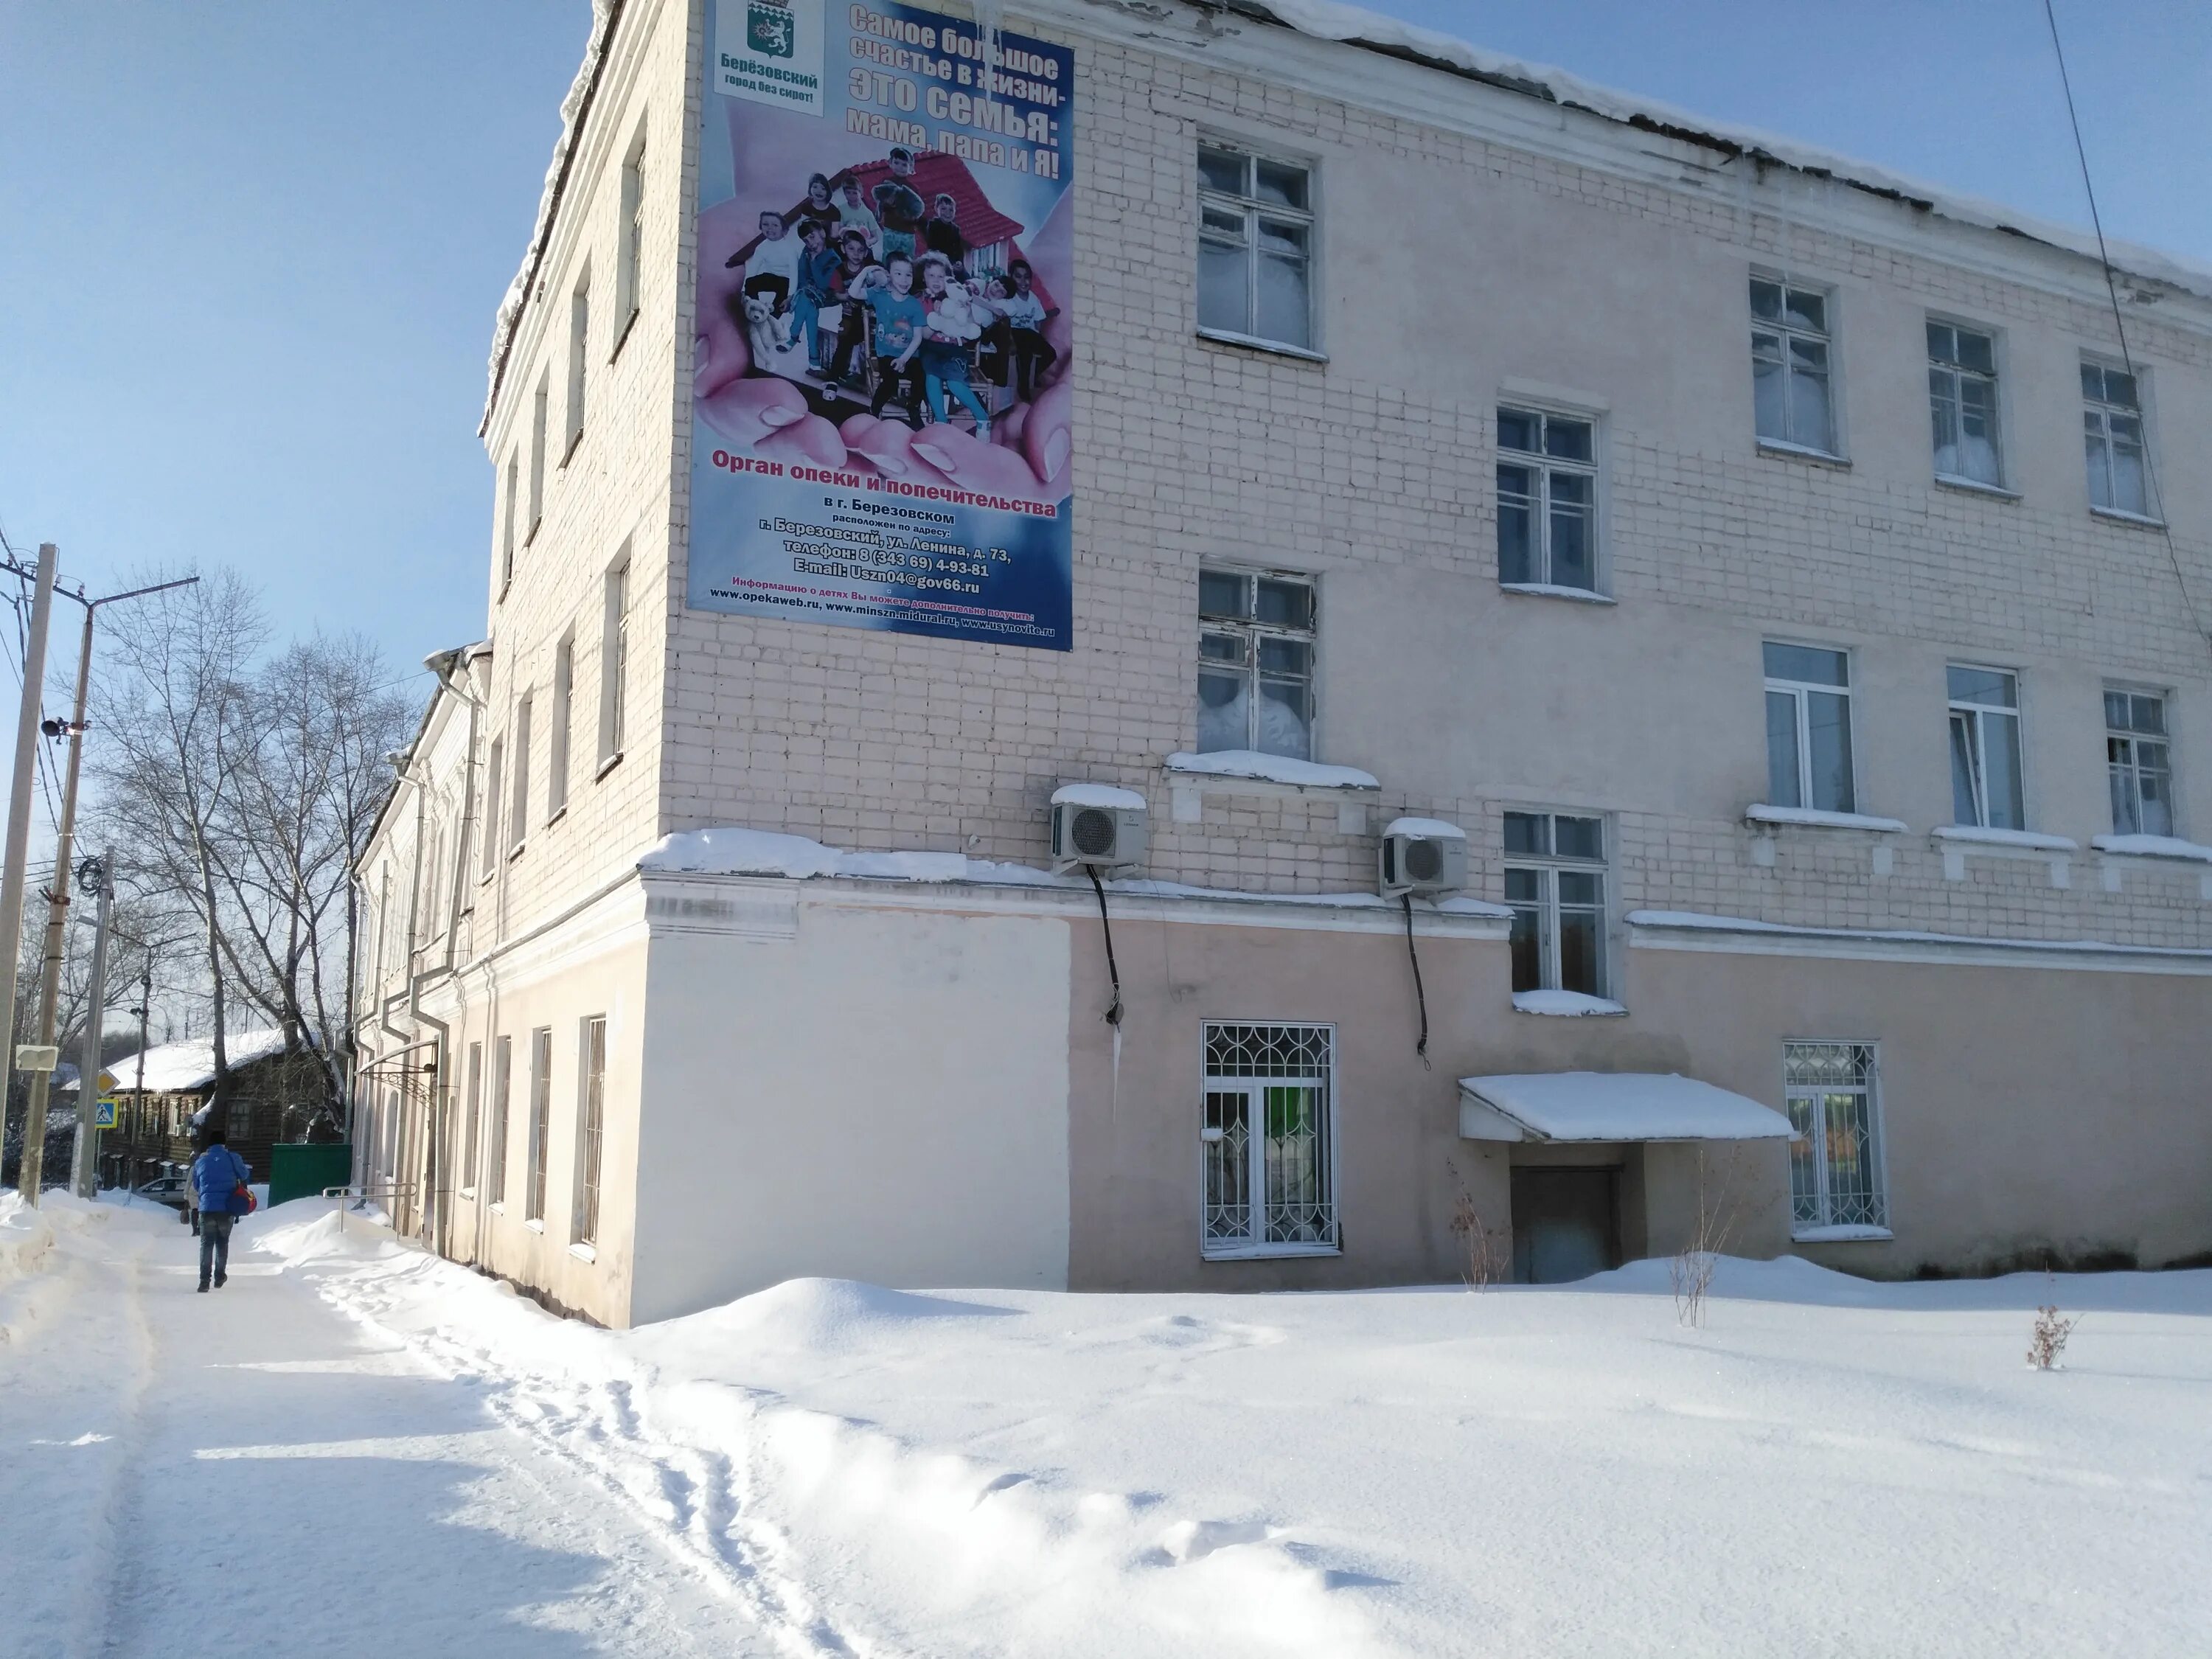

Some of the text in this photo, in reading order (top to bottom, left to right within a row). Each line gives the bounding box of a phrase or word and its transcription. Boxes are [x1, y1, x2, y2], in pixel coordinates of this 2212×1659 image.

[849, 4, 936, 49] Самое
[721, 53, 818, 89] Берёзовский
[849, 36, 952, 80] счастье
[958, 63, 972, 86] в
[725, 74, 813, 103] город без сирот!
[846, 108, 933, 152] мама,
[938, 130, 1005, 168] папа
[1011, 147, 1028, 173] и
[712, 450, 1056, 518] Орган опеки и попечительства
[824, 497, 955, 524] в г. Березовском
[832, 515, 950, 538] расположен по адресу:
[759, 518, 1012, 565] г. Березовский, ул. Ленина, д. 73,
[784, 540, 989, 577] телефон: 8 (343 69) 4-93-81
[794, 557, 980, 594] E-mail: Uszn04@gov66.ru
[710, 589, 1055, 638] www.opekaweb.ru, www.minszn.midural.ru, www.usynovite.ru
[732, 577, 807, 594] Информацию
[819, 589, 848, 599] детях
[851, 592, 866, 601] Вы
[869, 595, 910, 607] можете
[911, 600, 985, 616] дополнительно
[988, 609, 1034, 622] получить:
